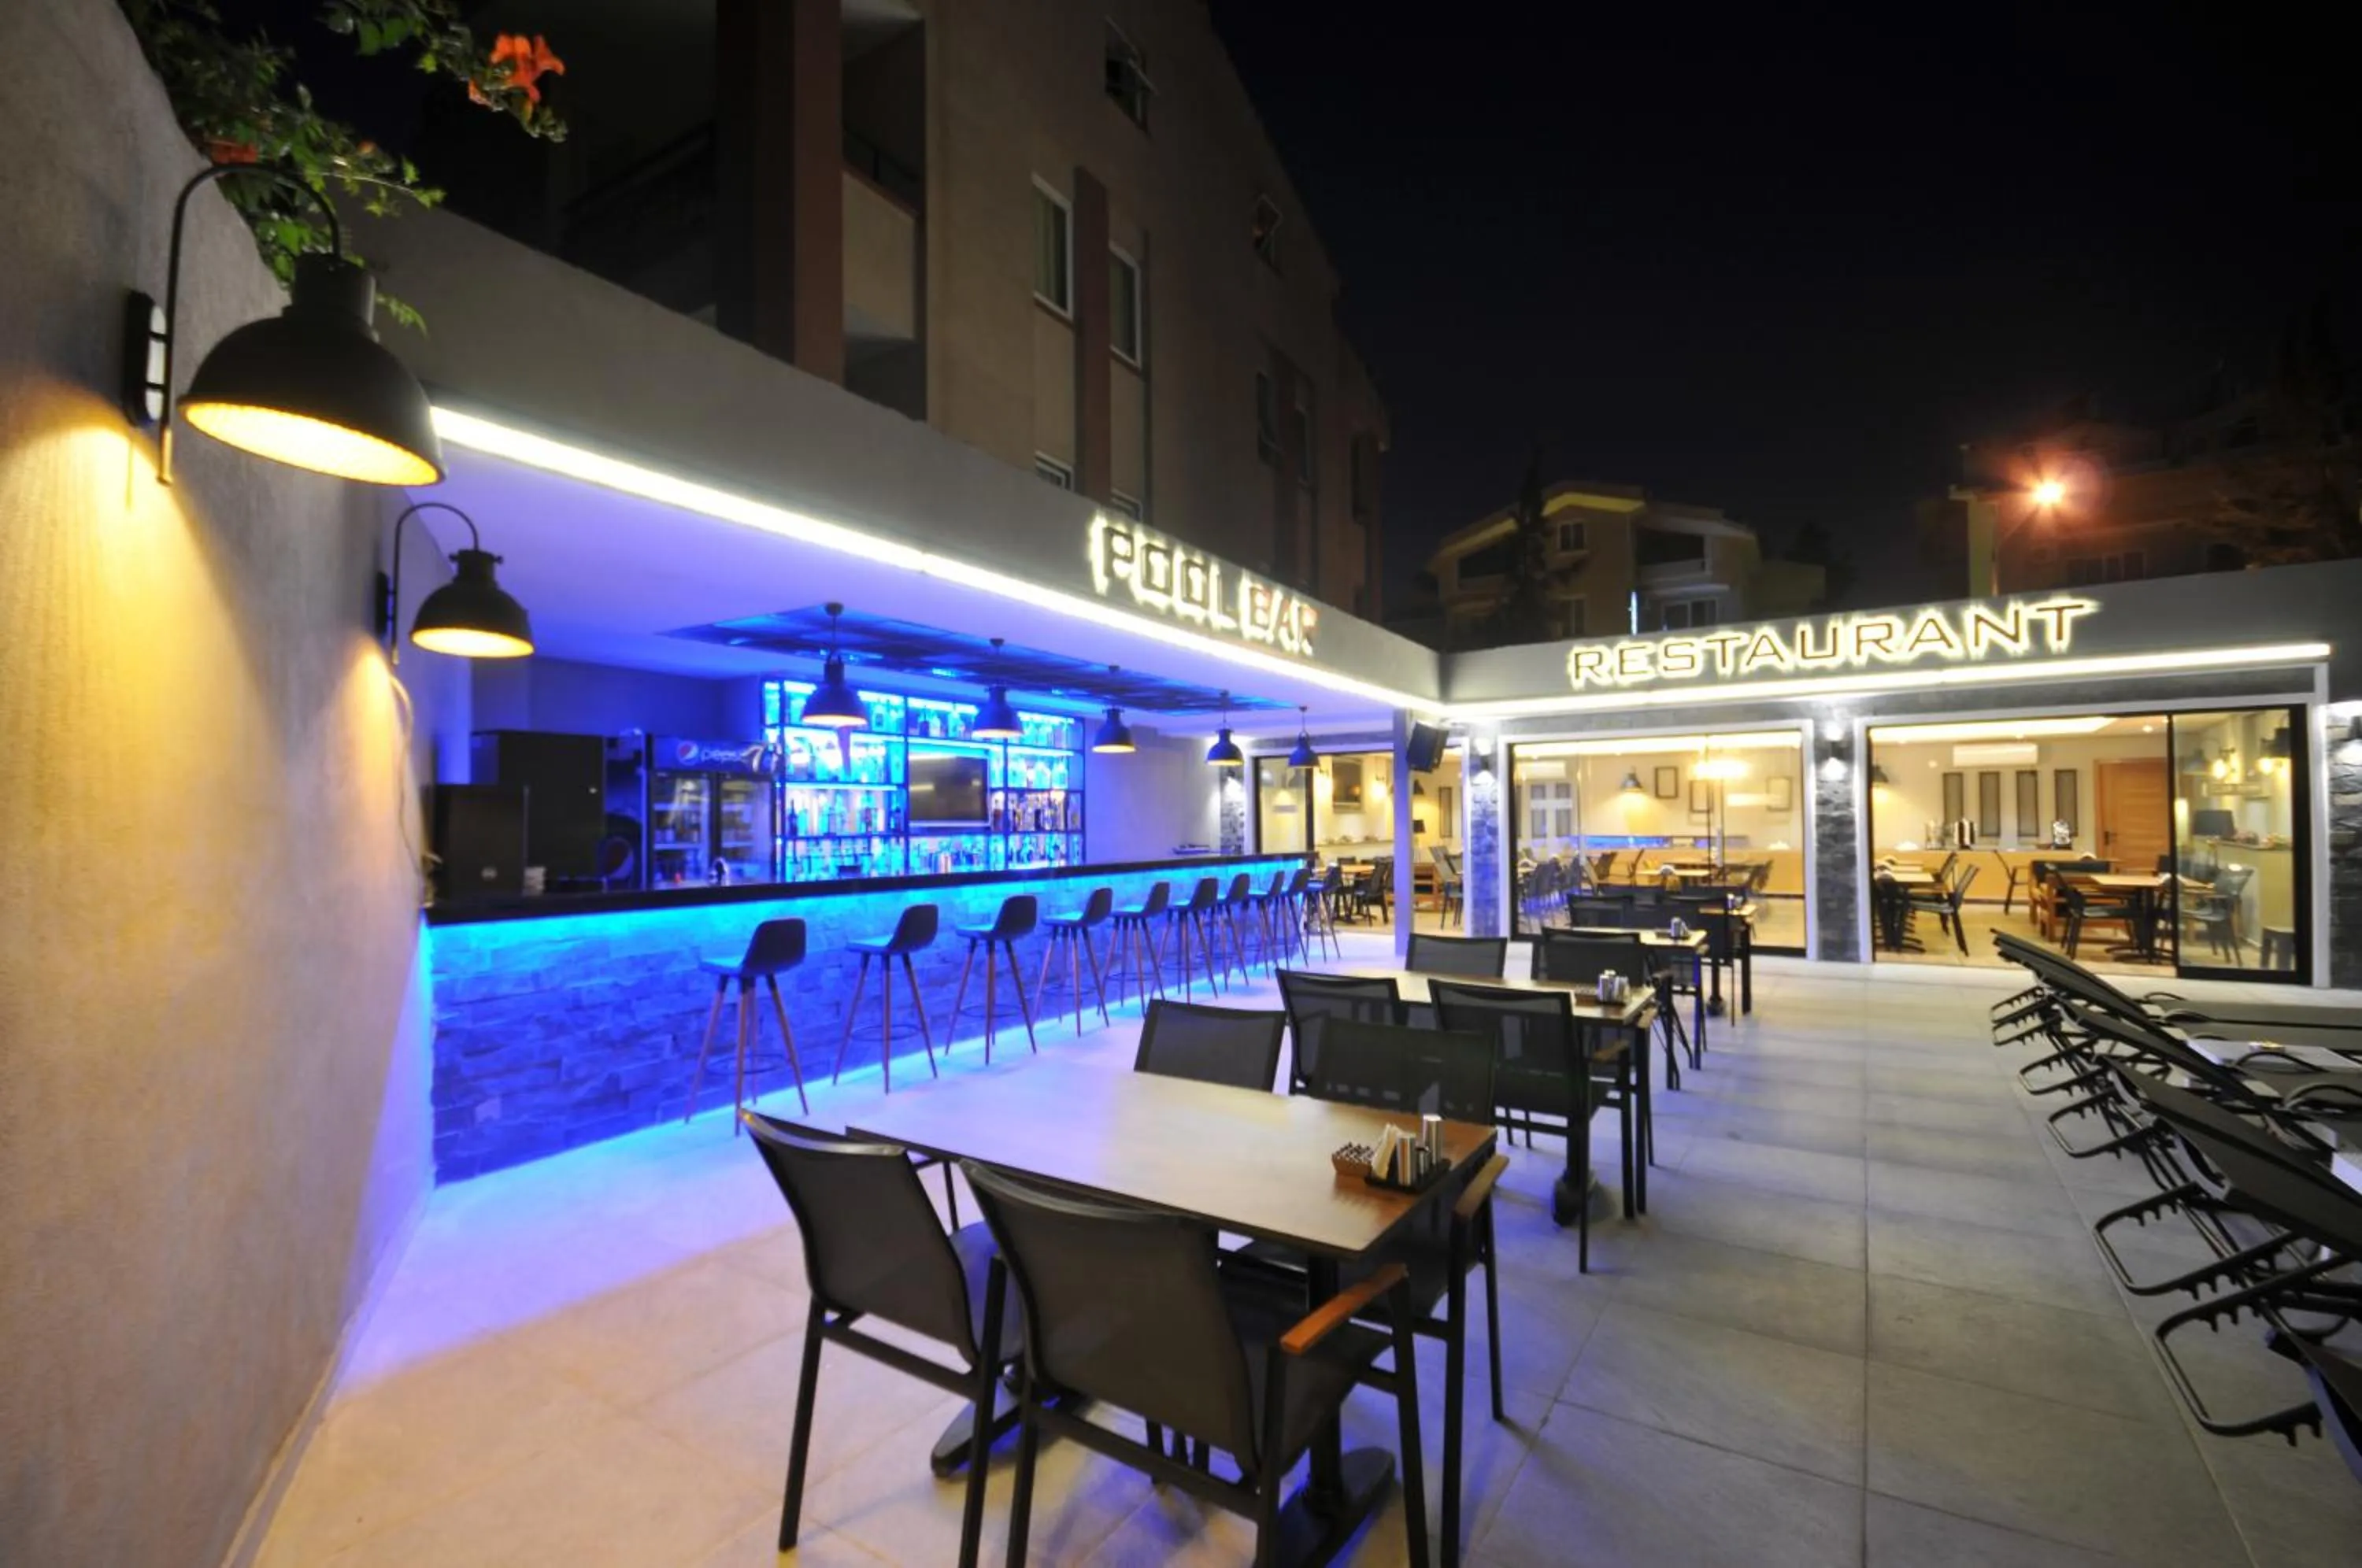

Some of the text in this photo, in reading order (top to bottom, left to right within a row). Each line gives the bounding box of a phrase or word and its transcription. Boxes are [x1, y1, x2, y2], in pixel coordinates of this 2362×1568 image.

[1088, 512, 1320, 656] POOL BAR
[1569, 598, 2096, 686] RESTAURANT
